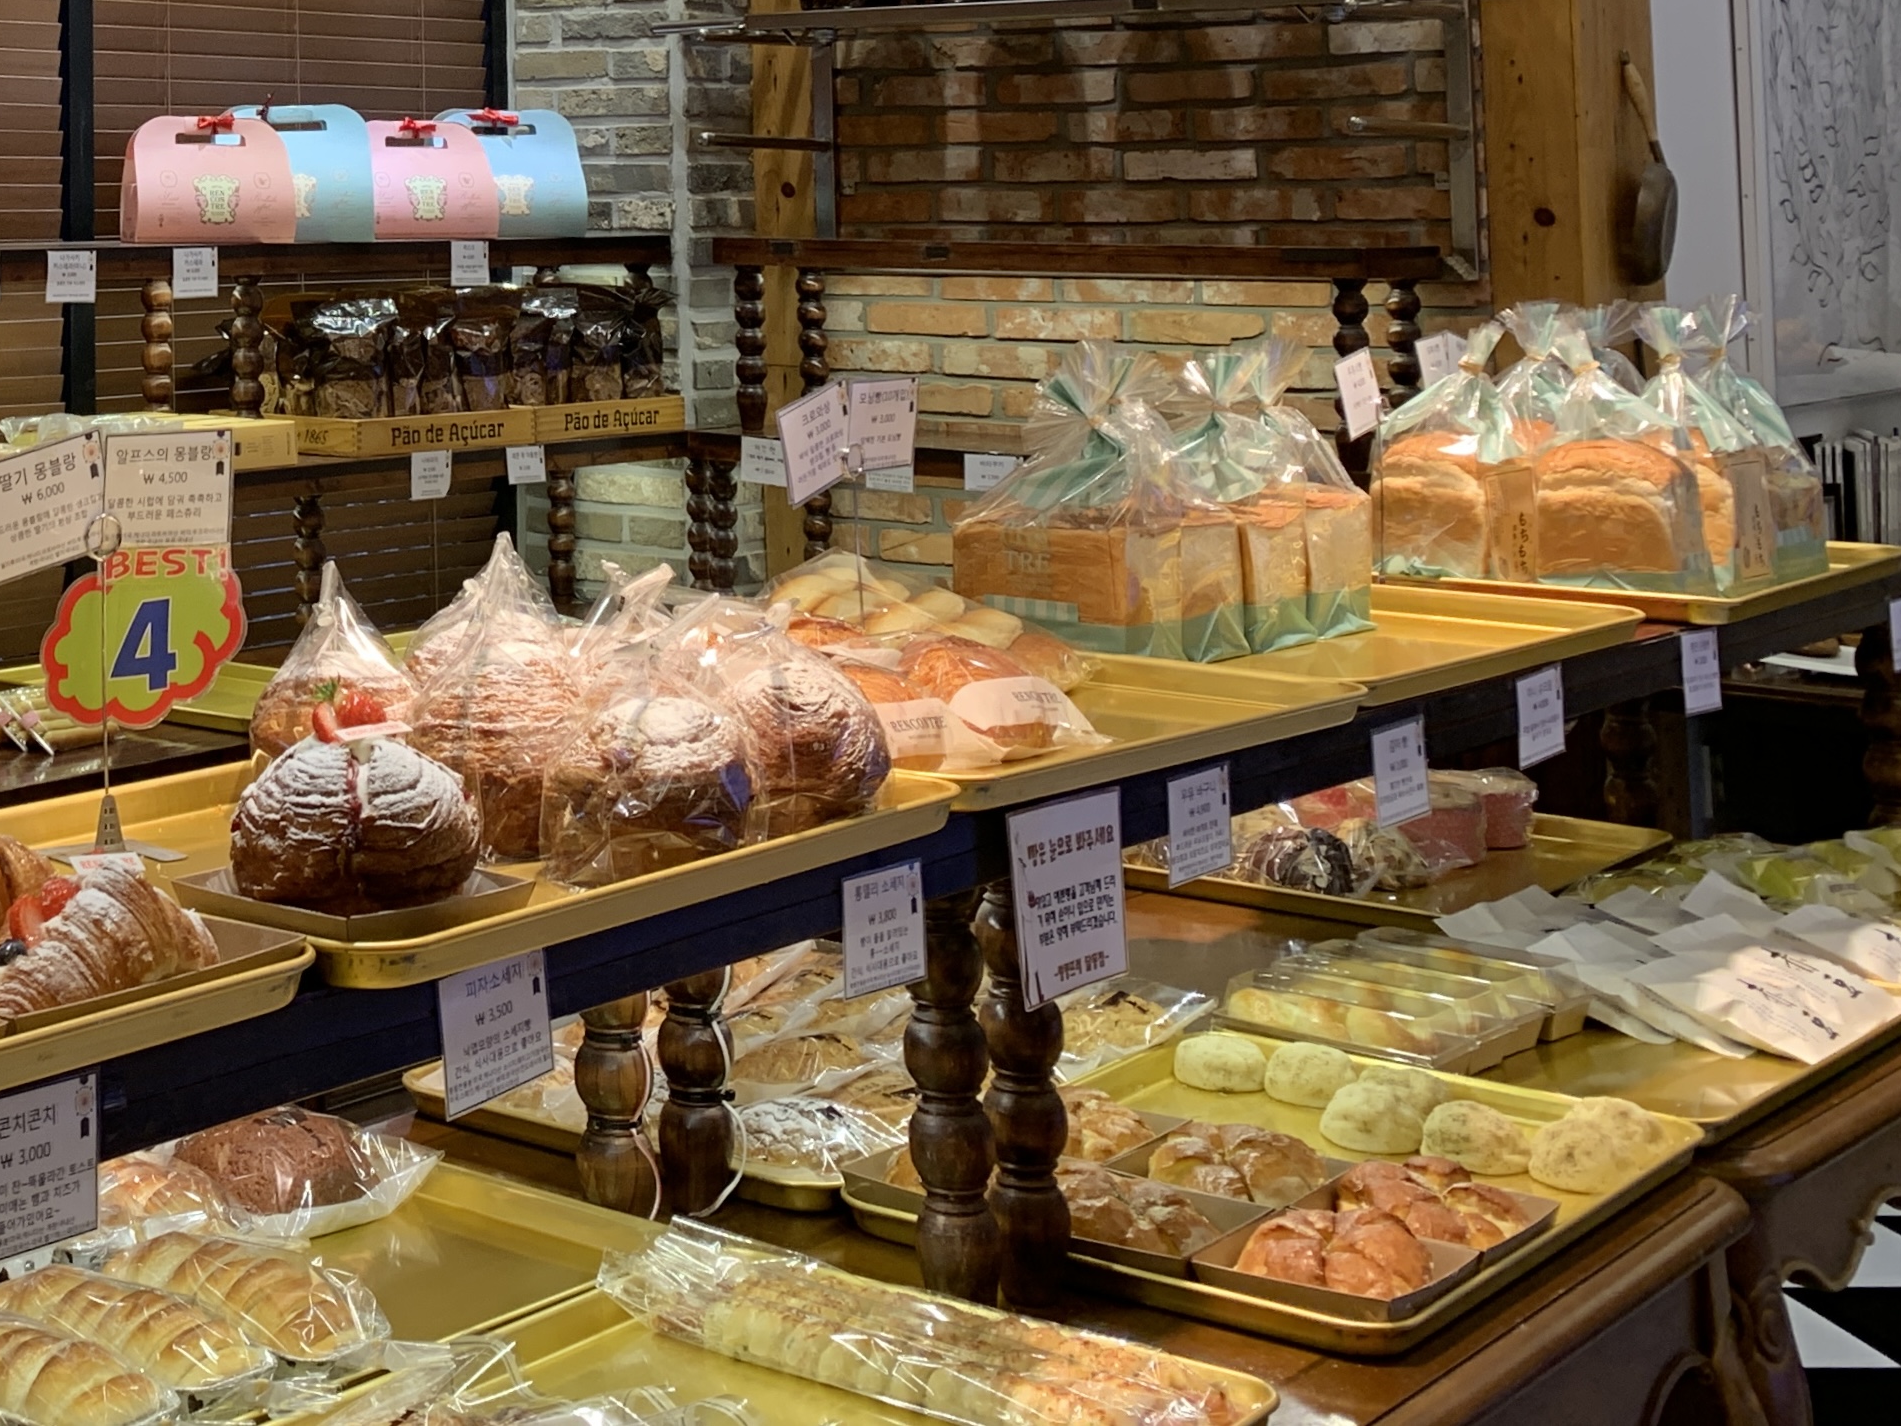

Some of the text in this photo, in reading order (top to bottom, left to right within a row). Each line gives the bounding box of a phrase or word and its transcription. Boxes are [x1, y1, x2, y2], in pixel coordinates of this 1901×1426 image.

[564, 408, 660, 431] Pão de Açúcar
[304, 428, 329, 445] 1865
[391, 420, 504, 447] Pão de Açúcar
[116, 445, 213, 465] 알프스의 몽블랑
[0, 468, 28, 492] 딸기
[34, 452, 76, 483] 몽블랑
[143, 472, 187, 484] ₩ 4,500
[21, 482, 65, 505] ₩ 6,000
[108, 496, 134, 509] 달콤한
[128, 510, 163, 521] 부드러운
[104, 547, 229, 580] BEST!
[109, 596, 179, 692] 4
[890, 715, 948, 733] RENCONTRE
[1027, 824, 1115, 867] 빵은 눈으로 봐주세요
[465, 961, 523, 999] 피자소세지
[474, 999, 513, 1026] ₩ 3,500
[521, 1030, 542, 1050] 좋아요
[0, 1141, 52, 1170] ₩ 3,000
[68, 1157, 95, 1177] 토스트
[53, 1179, 81, 1199] 치즈가
